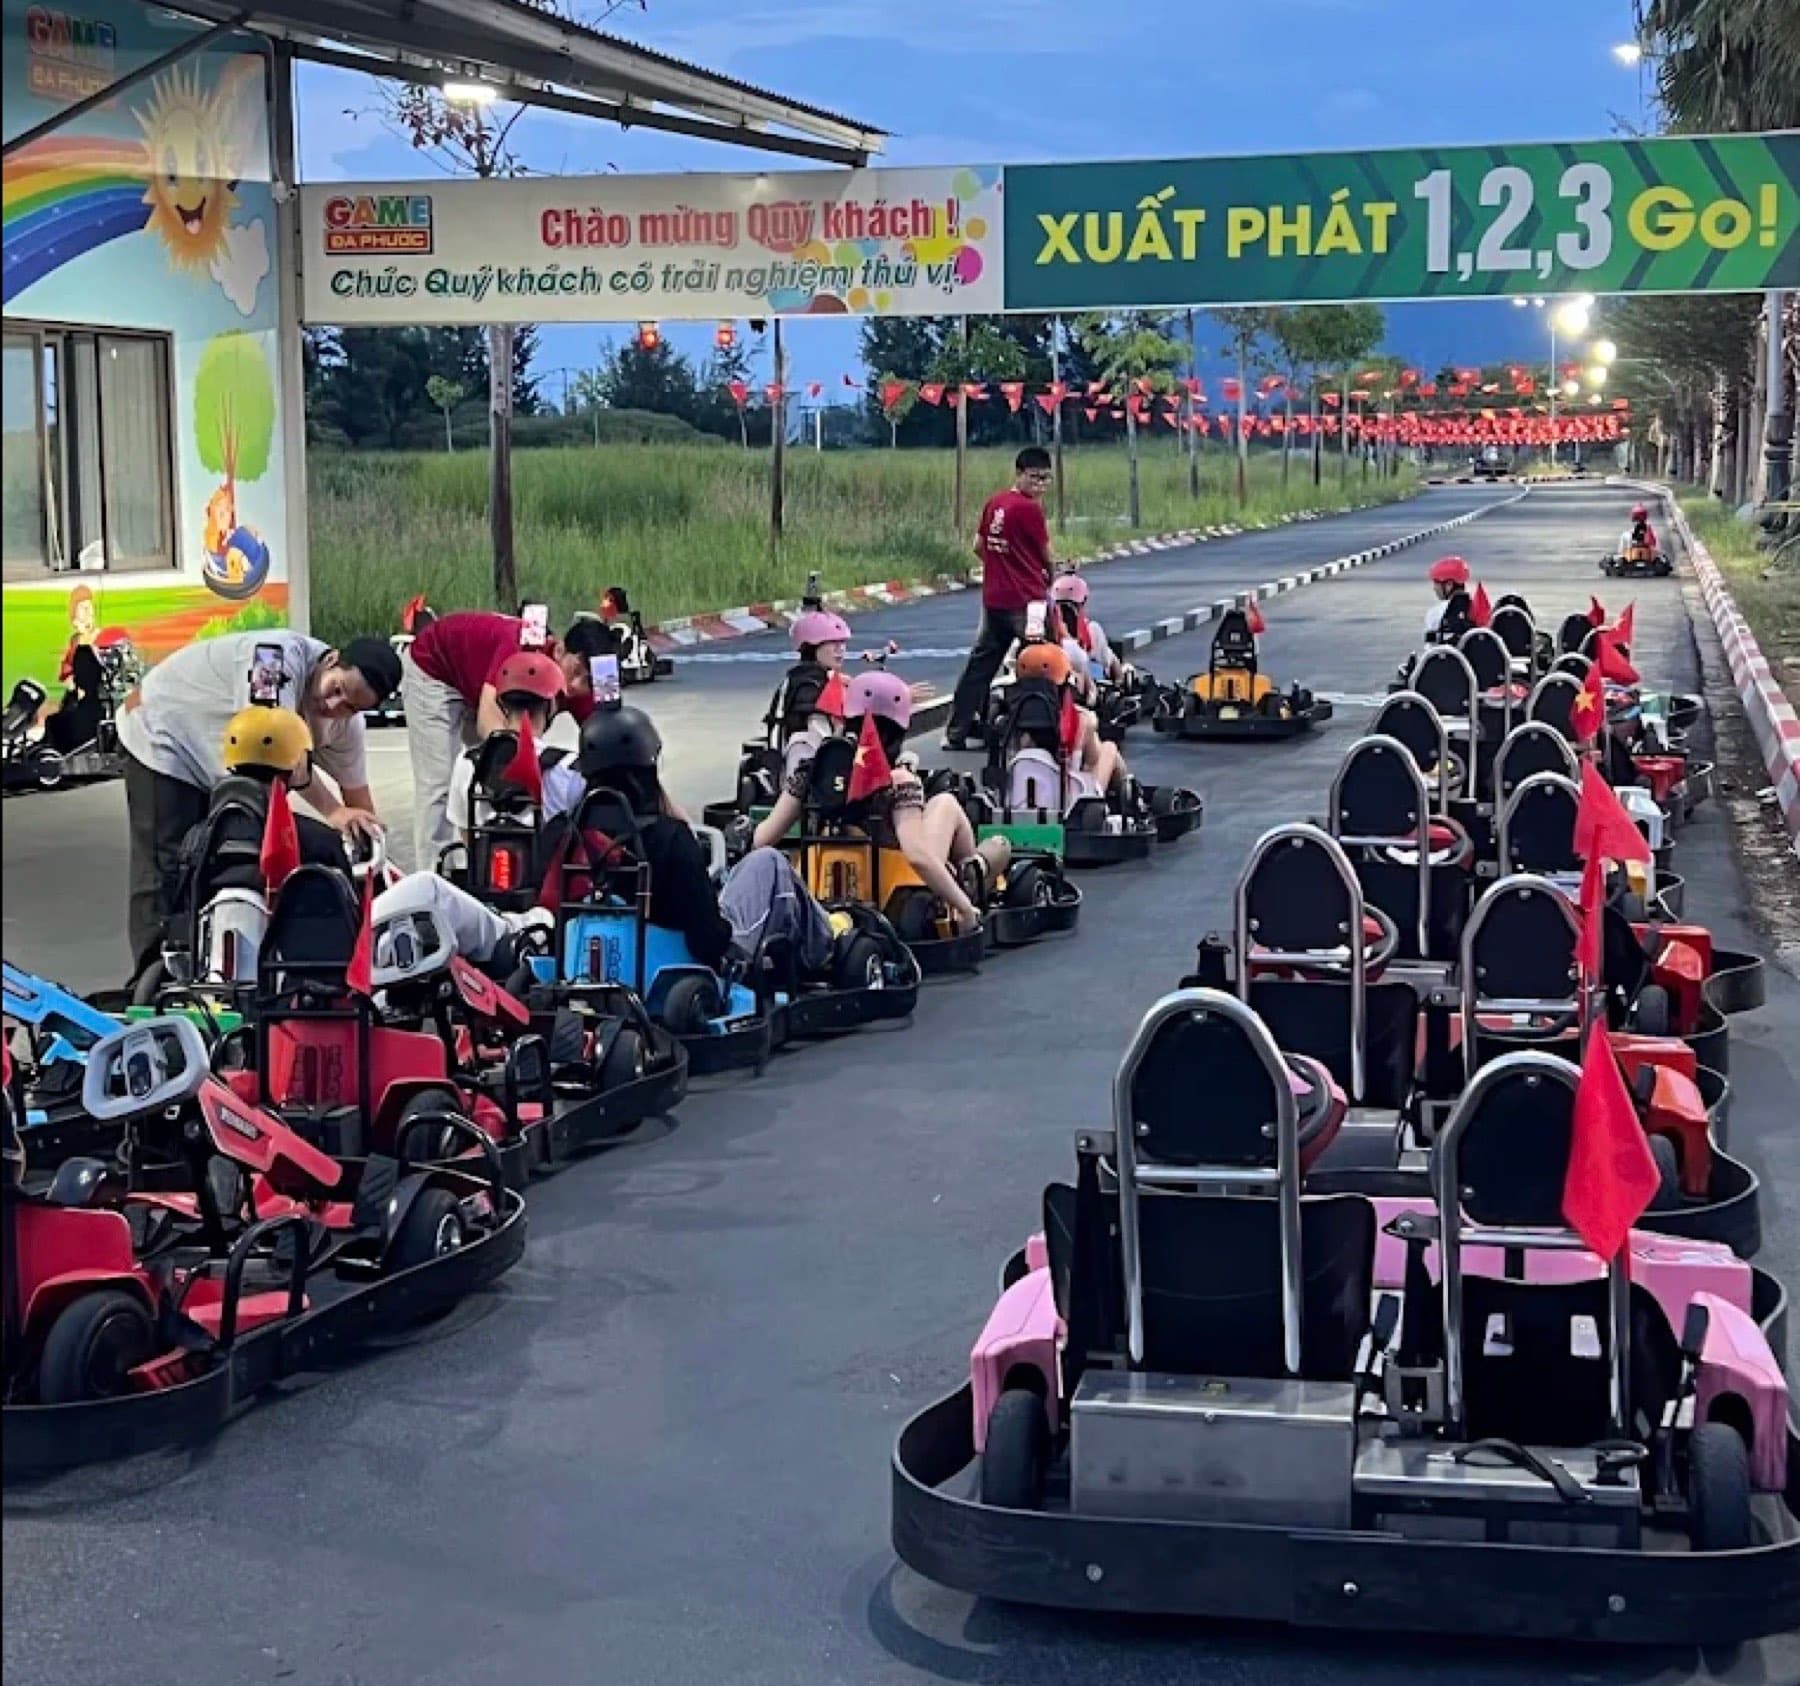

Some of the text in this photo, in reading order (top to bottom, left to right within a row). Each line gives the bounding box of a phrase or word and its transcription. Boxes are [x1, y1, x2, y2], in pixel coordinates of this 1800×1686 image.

[326, 196, 430, 226] GAME
[541, 207, 631, 248] Chào
[639, 204, 737, 249] mừng
[747, 200, 814, 249] Quý
[823, 196, 936, 241] khách
[1034, 162, 1778, 281] XUẤT PHÁT 1,2,3 Go!
[330, 265, 418, 297] Chúc
[497, 263, 602, 295] khách
[609, 262, 654, 295] có
[725, 257, 853, 300] nghiệm
[861, 253, 918, 290] thú
